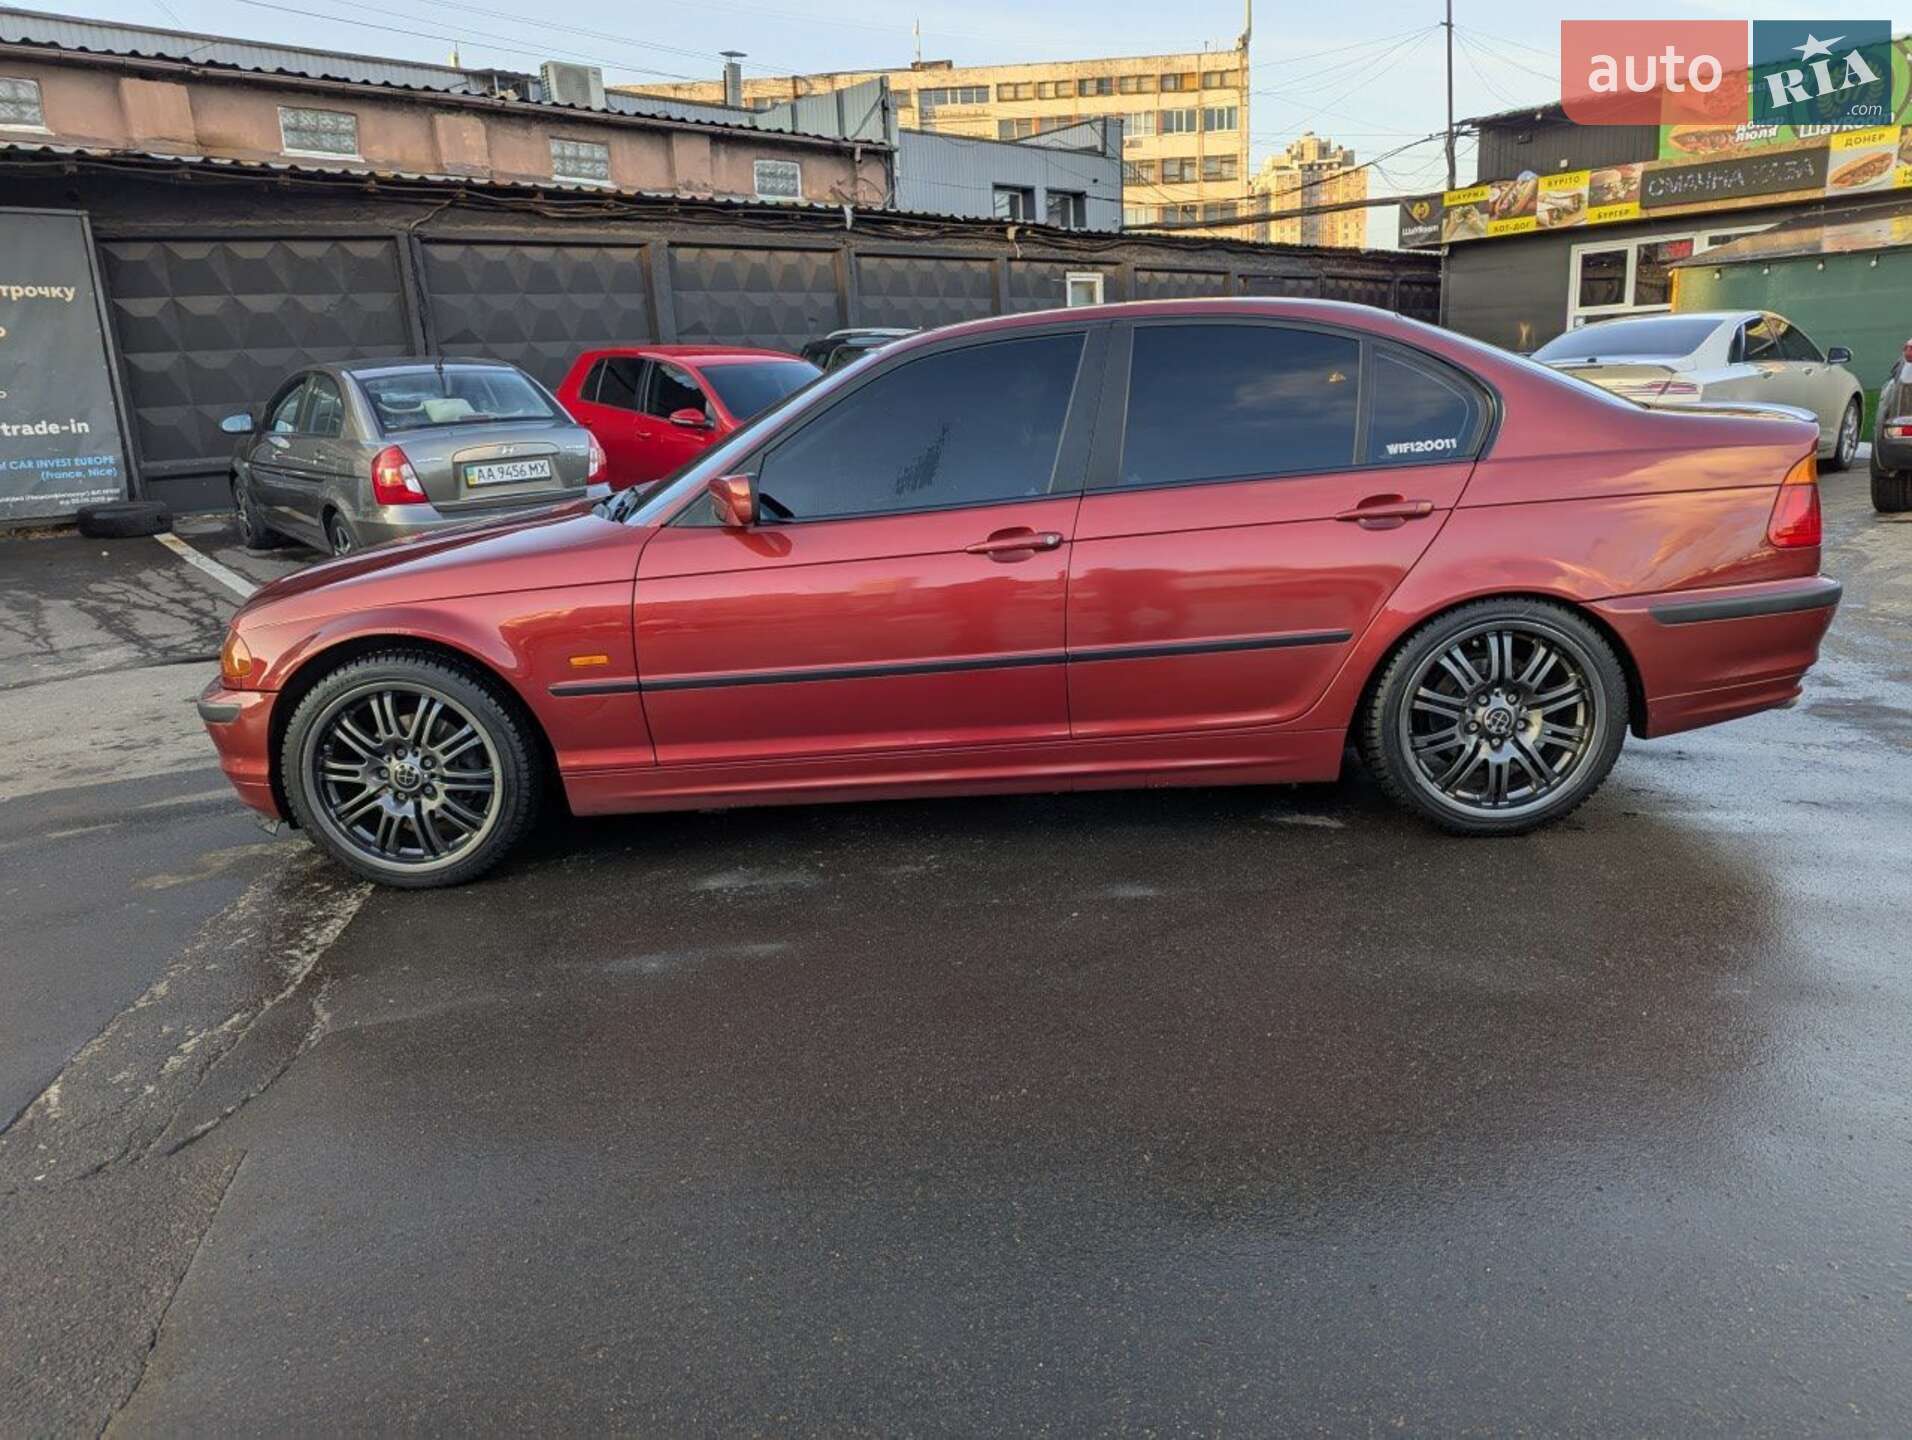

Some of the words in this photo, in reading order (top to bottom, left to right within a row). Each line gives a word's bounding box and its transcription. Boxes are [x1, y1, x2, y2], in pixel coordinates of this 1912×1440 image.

[1845, 133, 1886, 147] ДОНЕР
[0, 418, 89, 435] trade-in
[37, 458, 72, 469] INVEST
[75, 455, 114, 466] EUROPE
[477, 466, 496, 481] AA
[497, 464, 527, 479] 9456
[529, 461, 547, 476] MX
